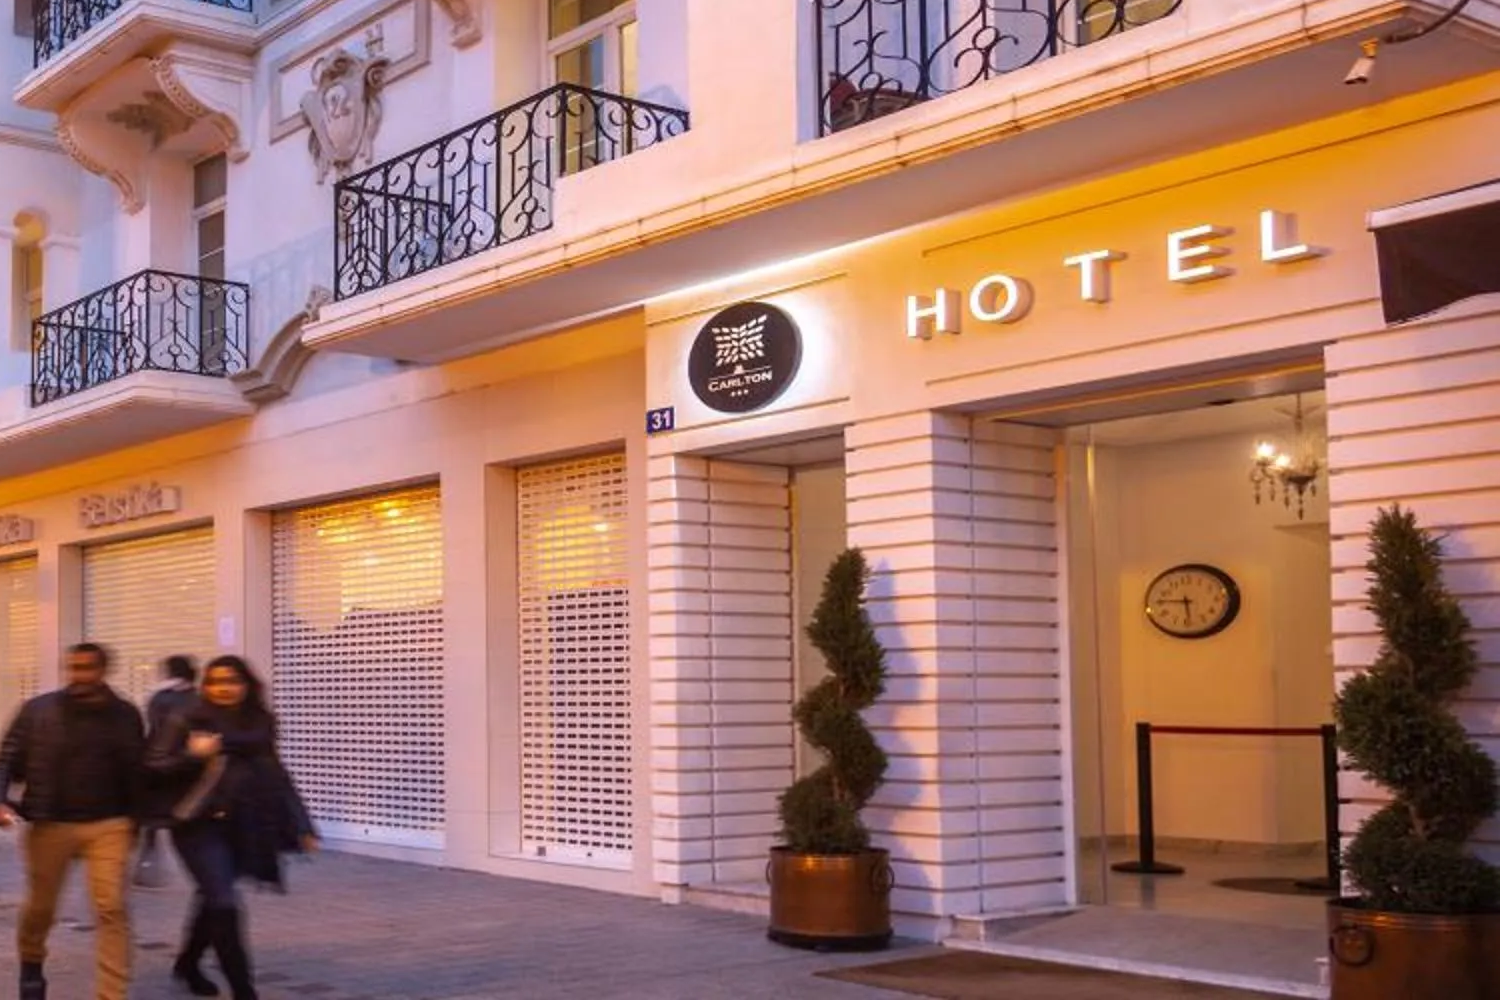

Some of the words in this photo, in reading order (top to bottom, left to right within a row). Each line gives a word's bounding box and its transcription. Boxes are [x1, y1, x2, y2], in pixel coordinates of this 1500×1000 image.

[906, 209, 1323, 340] HOTEL
[707, 370, 773, 393] CARLTON
[651, 410, 672, 430] 31
